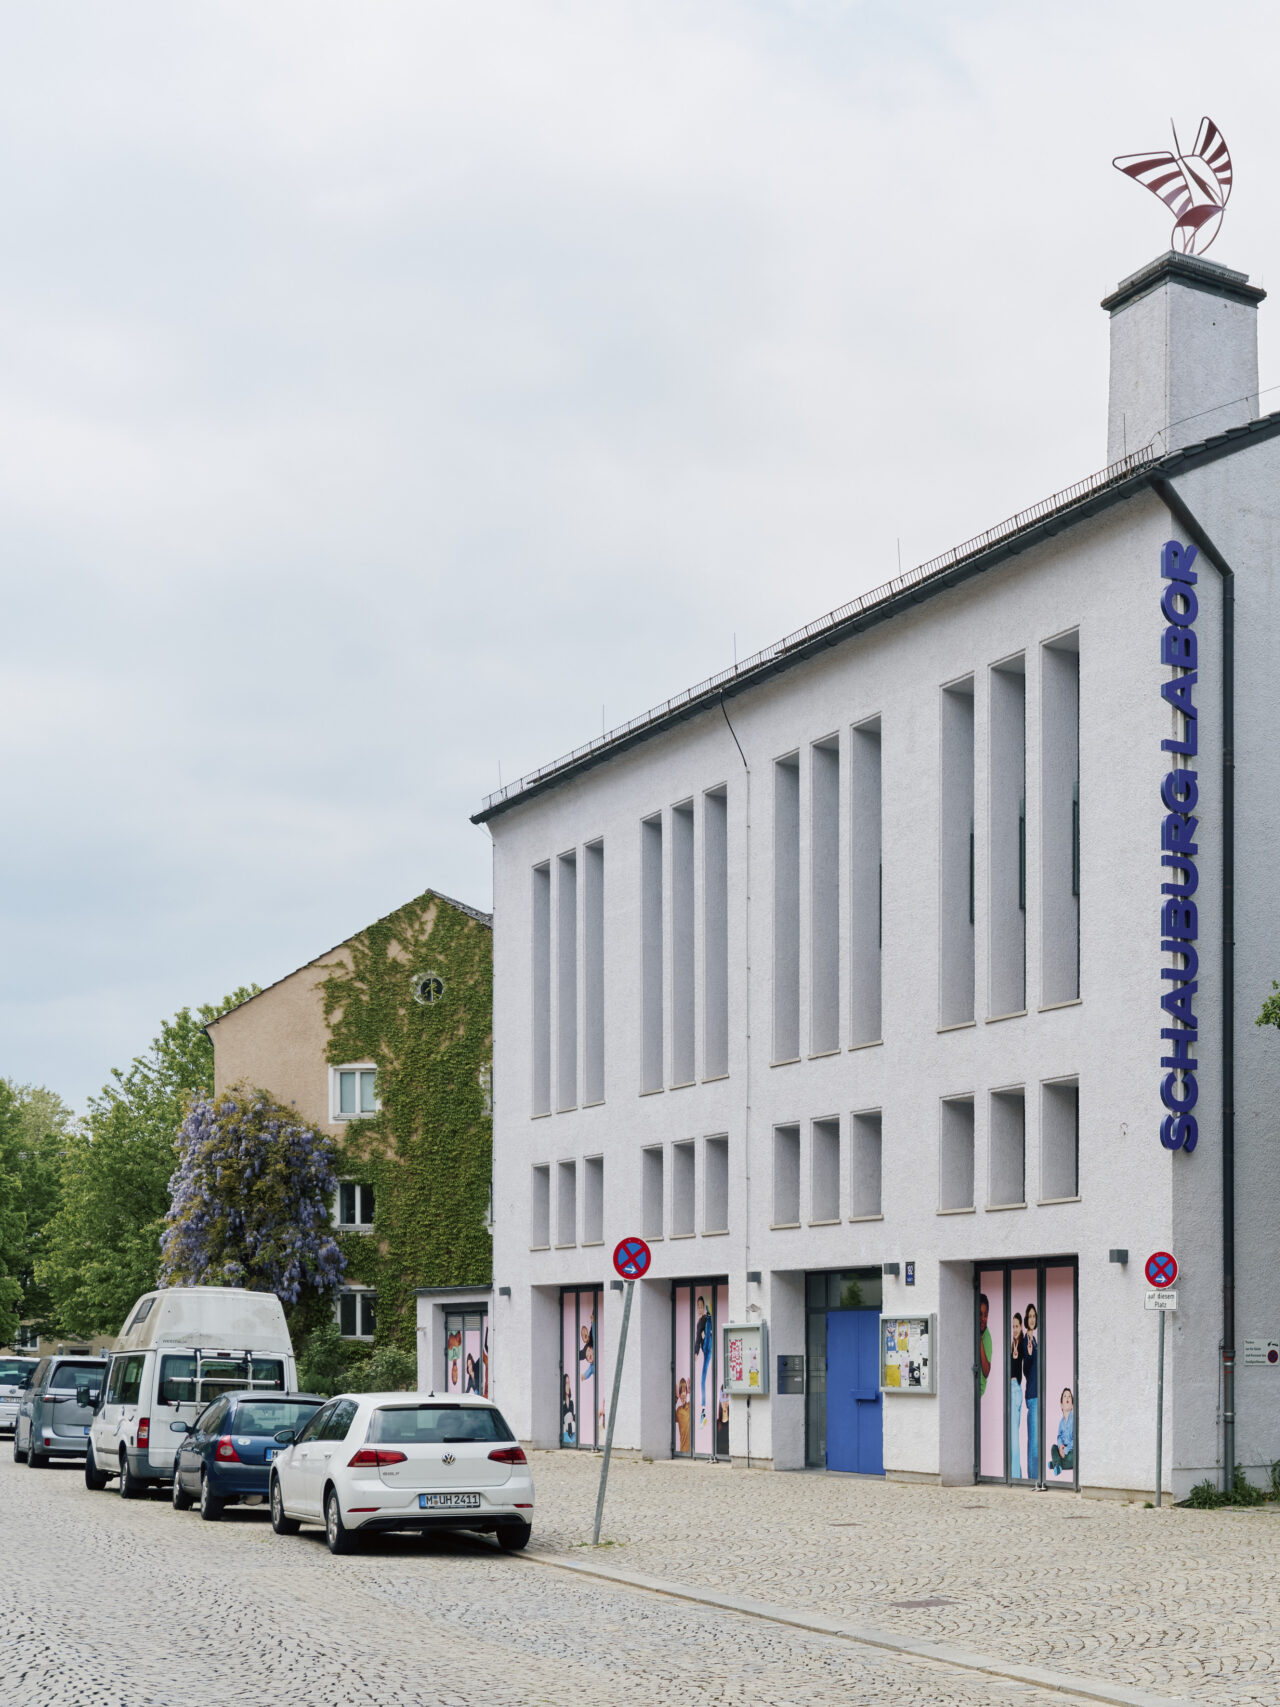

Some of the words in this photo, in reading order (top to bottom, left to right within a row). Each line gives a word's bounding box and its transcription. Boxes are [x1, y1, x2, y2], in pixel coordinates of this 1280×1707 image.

[1160, 539, 1199, 756] LABOR
[1160, 768, 1199, 1153] SCHAUBURG
[1157, 1292, 1175, 1300] diesem
[426, 1495, 433, 1505] M
[439, 1495, 453, 1505] UH
[454, 1495, 479, 1504] 2411
